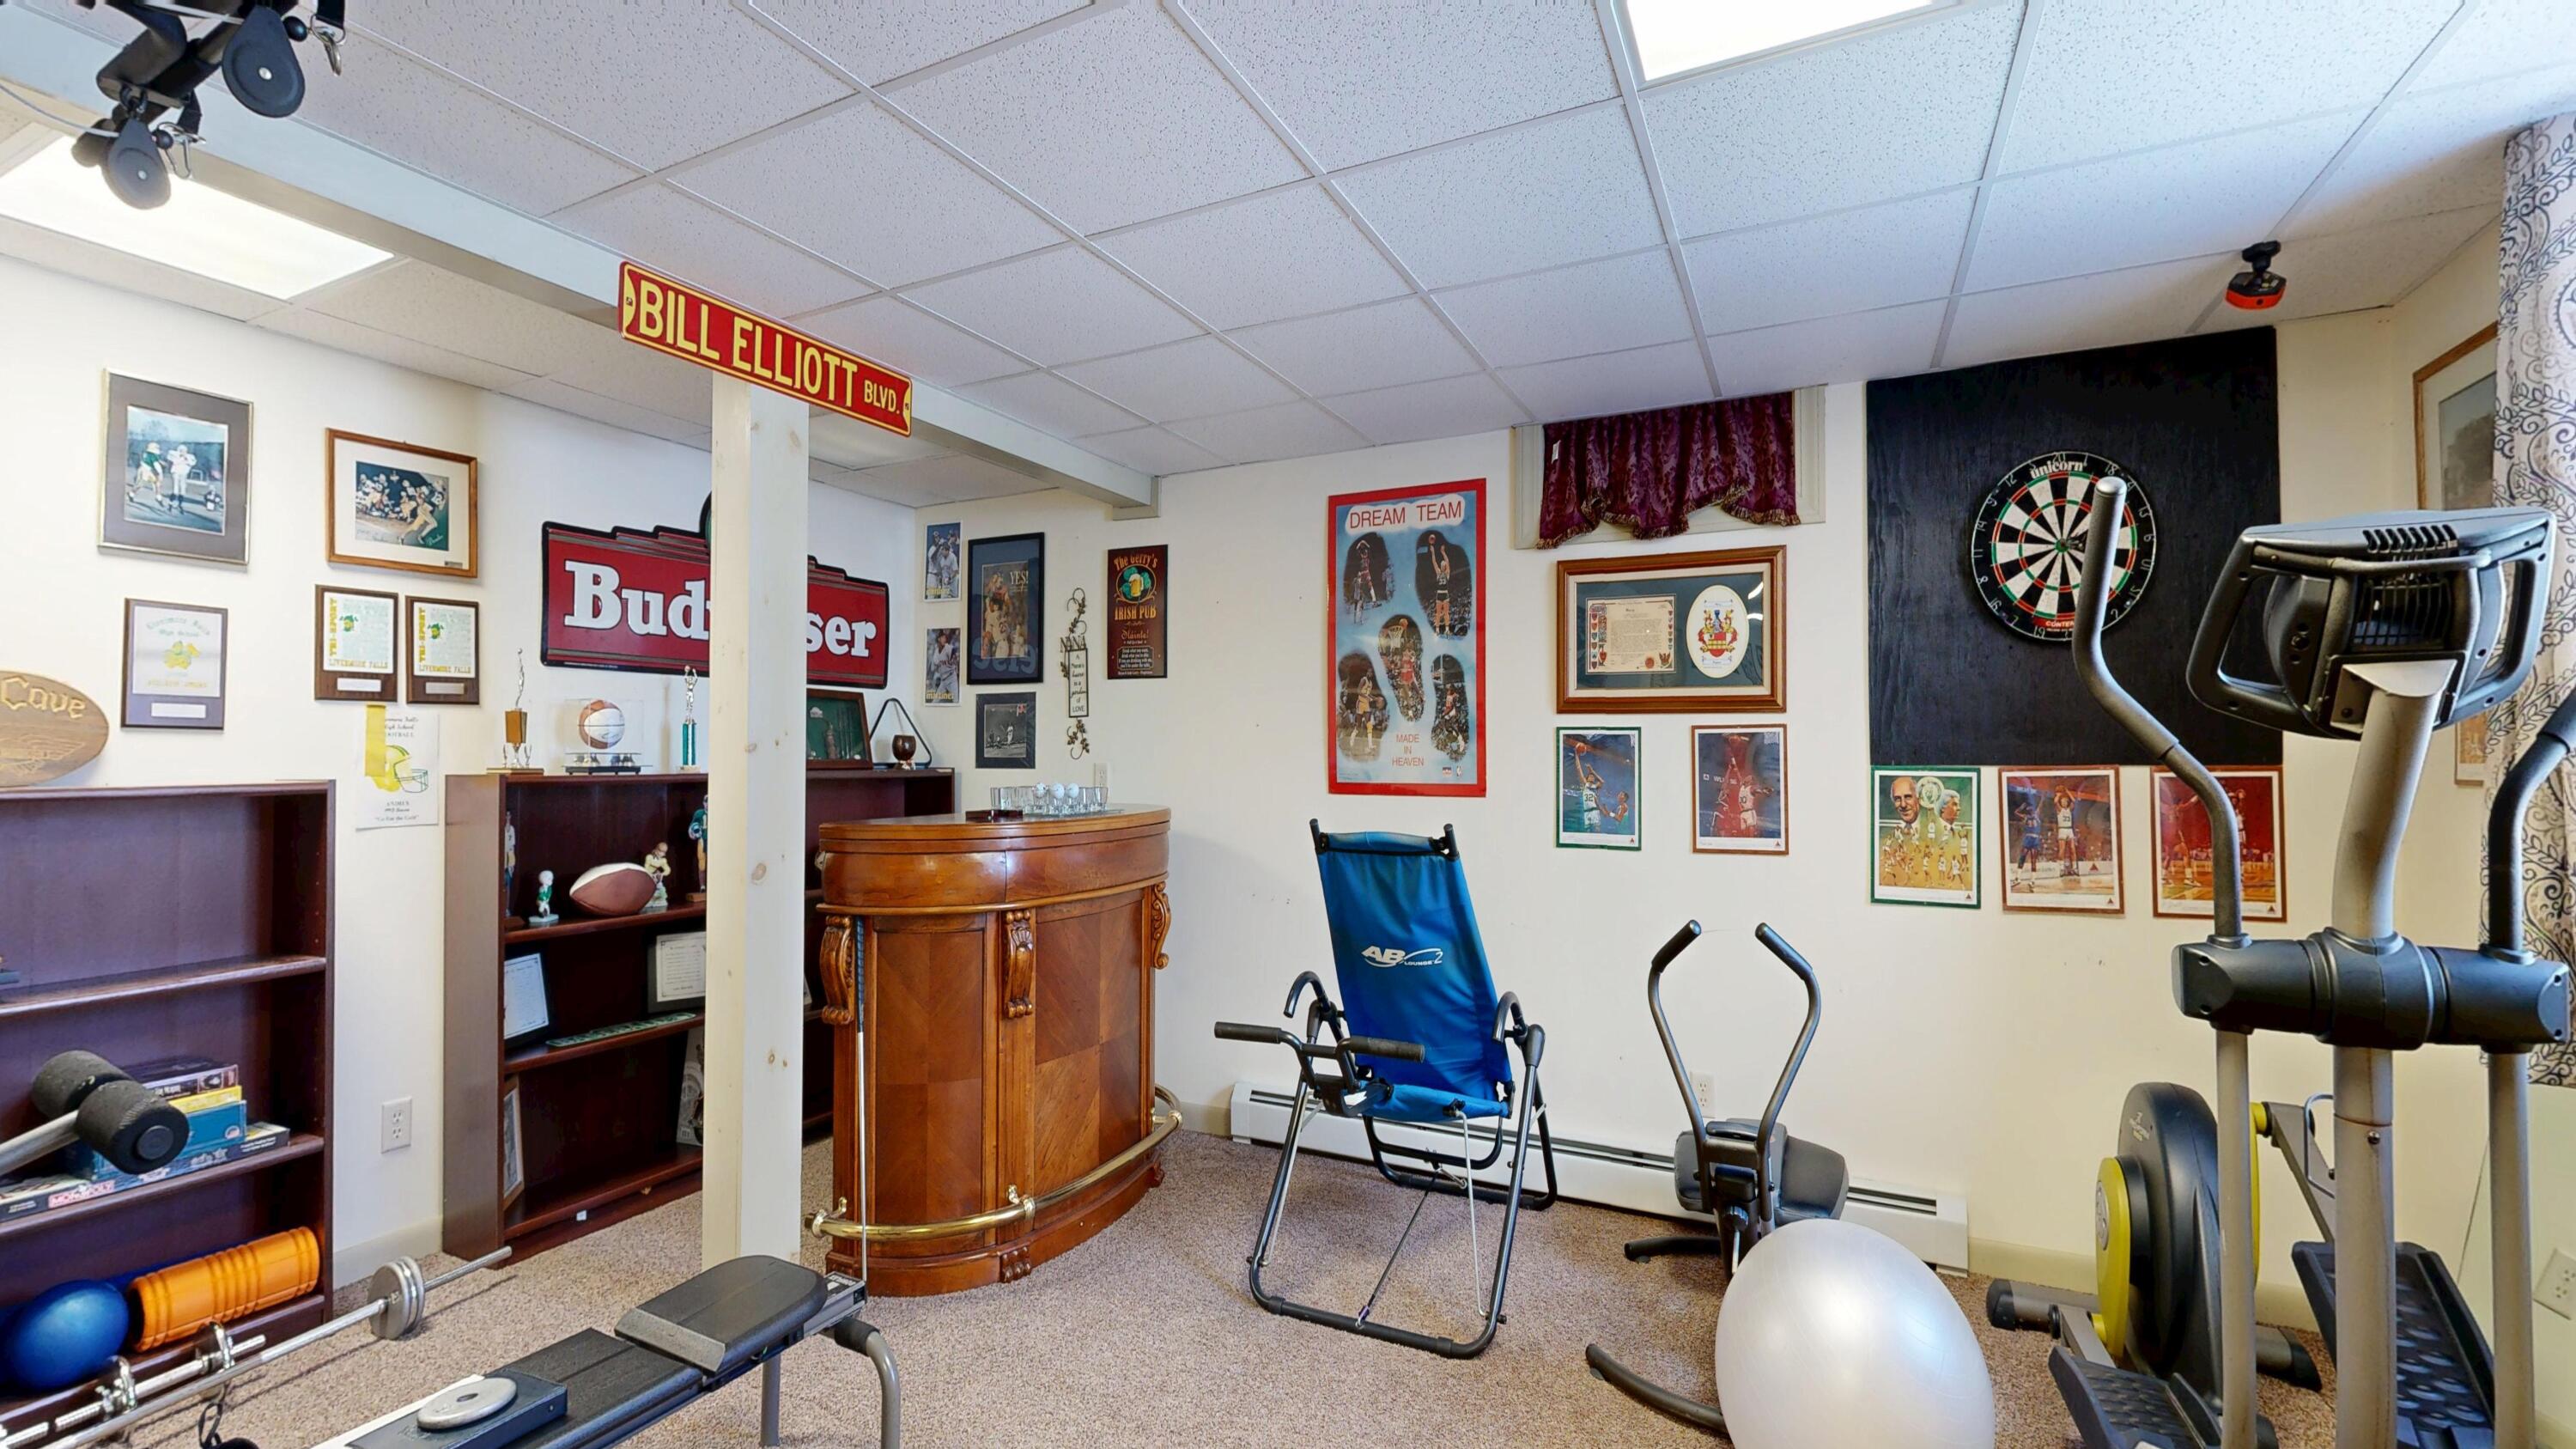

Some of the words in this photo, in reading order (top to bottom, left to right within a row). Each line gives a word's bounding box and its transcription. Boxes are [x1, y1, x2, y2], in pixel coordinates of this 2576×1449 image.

[639, 279, 720, 362] BILL
[732, 315, 858, 408] ELLIOTT
[863, 379, 900, 415] BLVD.
[2030, 460, 2083, 479] unicorn
[1350, 506, 1406, 529] DREAM
[1416, 501, 1461, 522] TEAM
[1114, 556, 1129, 571] The
[1130, 553, 1158, 569] Gerry's
[1010, 570, 1029, 585] YES!
[564, 559, 878, 658] Budser
[1115, 606, 1137, 620] IRISH
[1139, 605, 1157, 618] PUB
[0, 676, 86, 718] Cave
[1072, 704, 1085, 713] LOVE
[1395, 734, 1420, 743] MADE
[1403, 745, 1413, 754] IN
[1392, 756, 1425, 767] HEAVEN
[1583, 793, 1594, 802] 32
[1361, 946, 1406, 964] AB
[1434, 951, 1443, 964] 2
